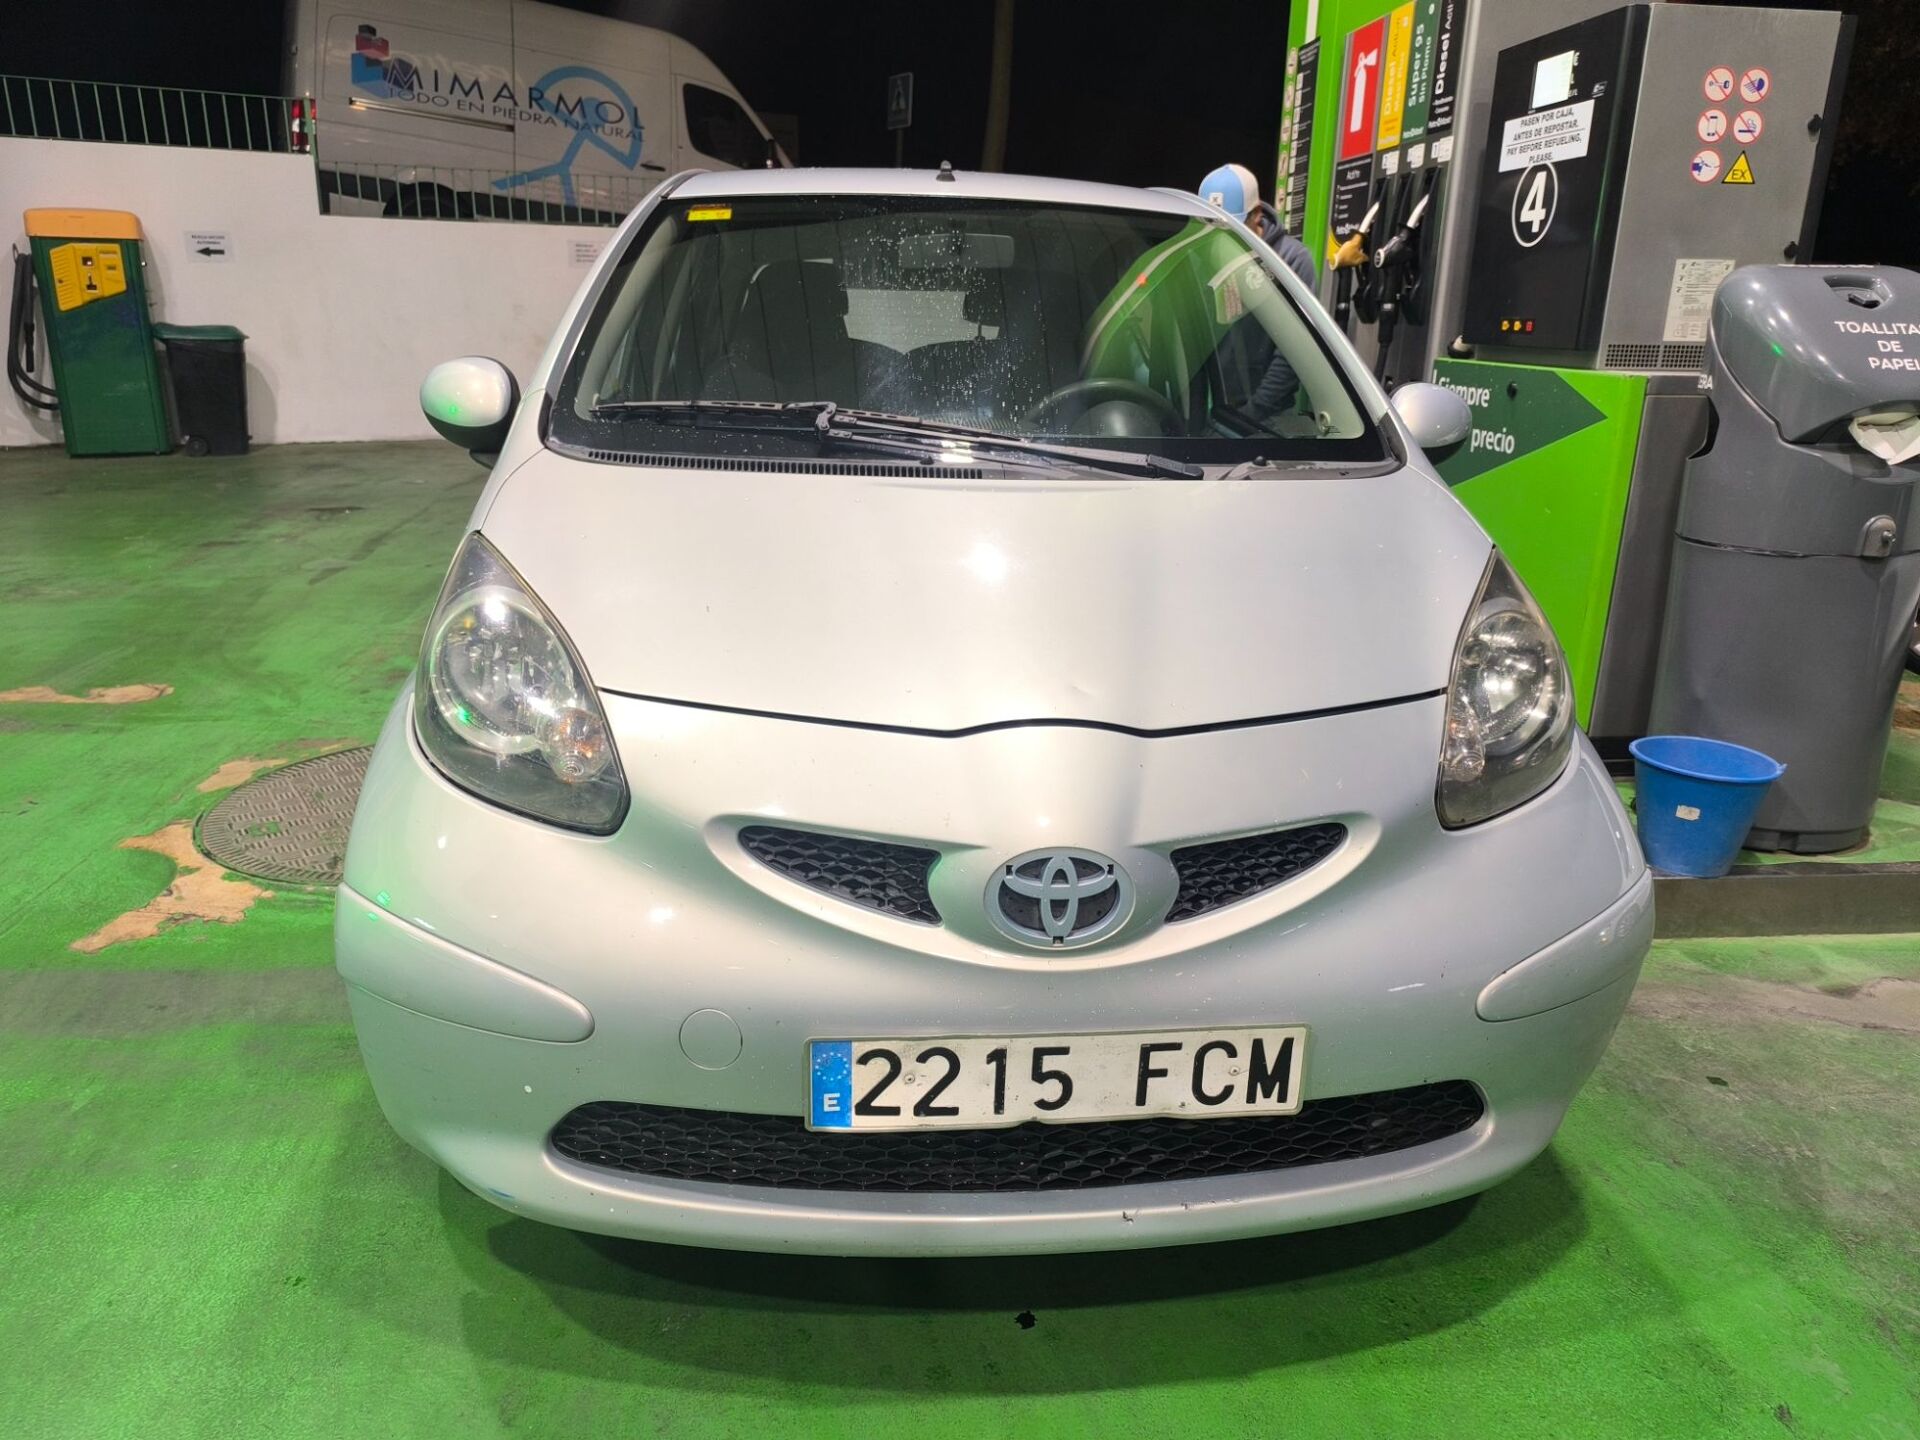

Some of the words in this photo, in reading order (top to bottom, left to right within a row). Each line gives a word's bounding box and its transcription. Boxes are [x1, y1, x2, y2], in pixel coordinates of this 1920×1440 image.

[1421, 36, 1432, 80] Plomo
[1435, 33, 1450, 94] Diesel
[1444, 0, 1454, 30] Acti
[1408, 52, 1421, 107] Super
[1415, 23, 1424, 48] 95
[387, 62, 645, 130] MIMARMOL
[1418, 82, 1427, 103] Sin
[388, 87, 449, 108] TODO
[457, 99, 485, 114] EN
[493, 105, 557, 128] PIEDRA
[565, 119, 643, 142] NATURAL
[1541, 112, 1555, 123] POR
[1513, 128, 1533, 142] ANTES
[1534, 126, 1543, 138] DE
[1506, 146, 1518, 157] PAY
[1519, 141, 1543, 155] BEFORE
[1731, 169, 1748, 181] EX
[1519, 170, 1548, 234] 4
[1834, 321, 1920, 335] TOALLITA
[1877, 340, 1904, 353] DE
[1470, 427, 1516, 454] precio
[822, 1093, 841, 1112] E
[853, 1045, 1074, 1117] 2215
[1134, 1036, 1295, 1108] FCM
